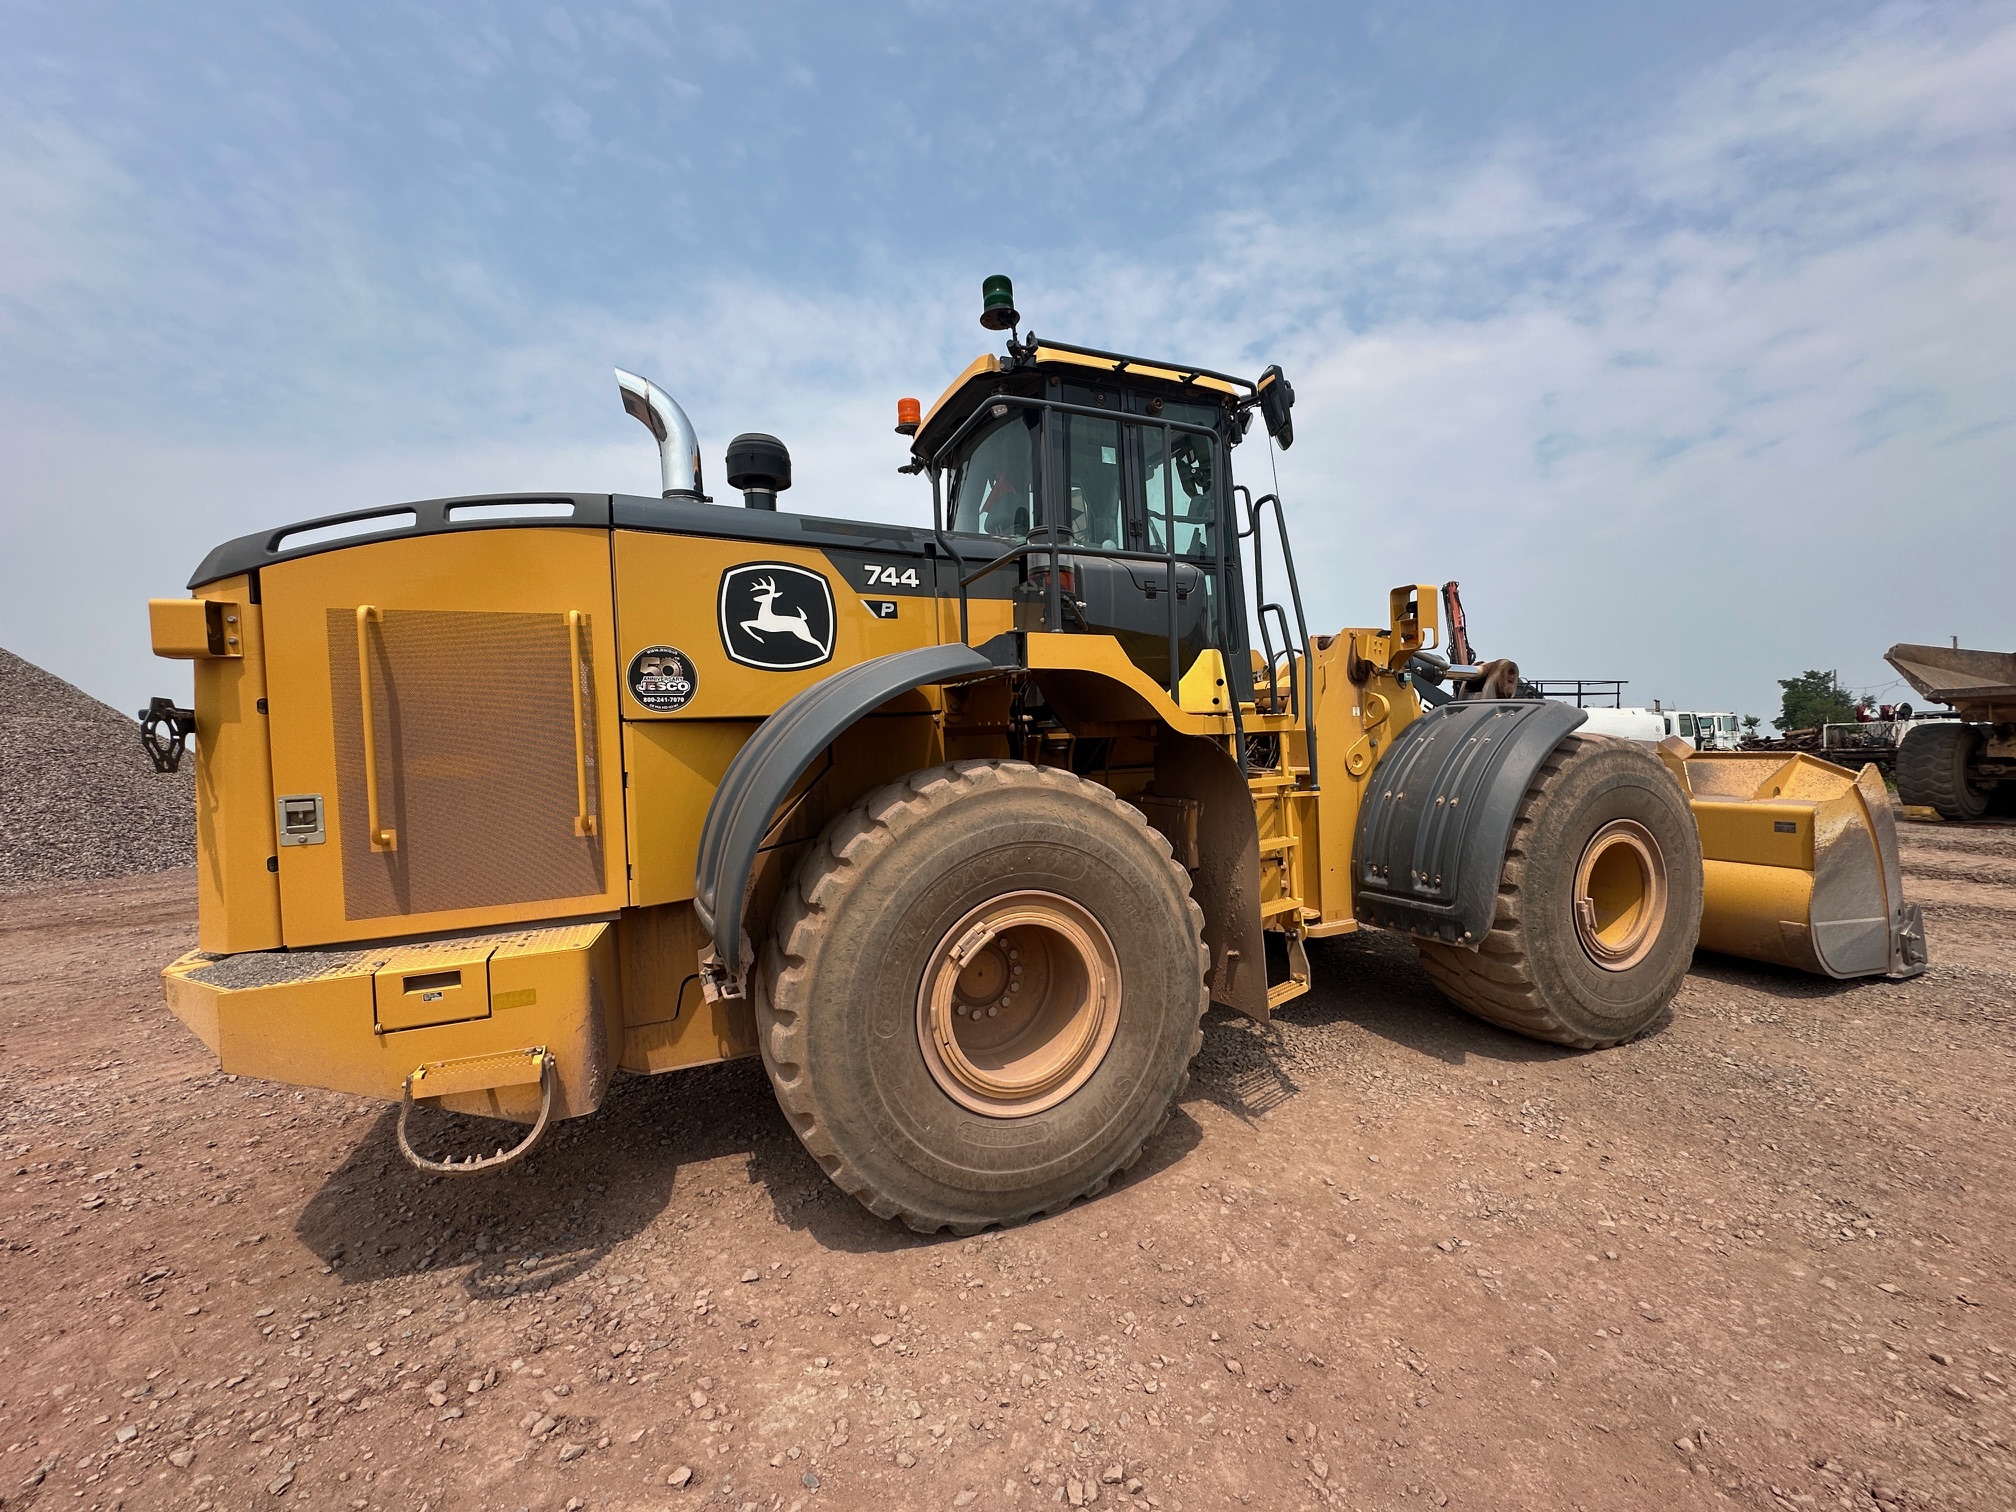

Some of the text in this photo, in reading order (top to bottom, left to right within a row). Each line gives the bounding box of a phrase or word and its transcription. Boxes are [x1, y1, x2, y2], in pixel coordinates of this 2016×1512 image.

[864, 565, 920, 588] 744
[880, 603, 895, 617] P
[637, 681, 689, 691] JESCO
